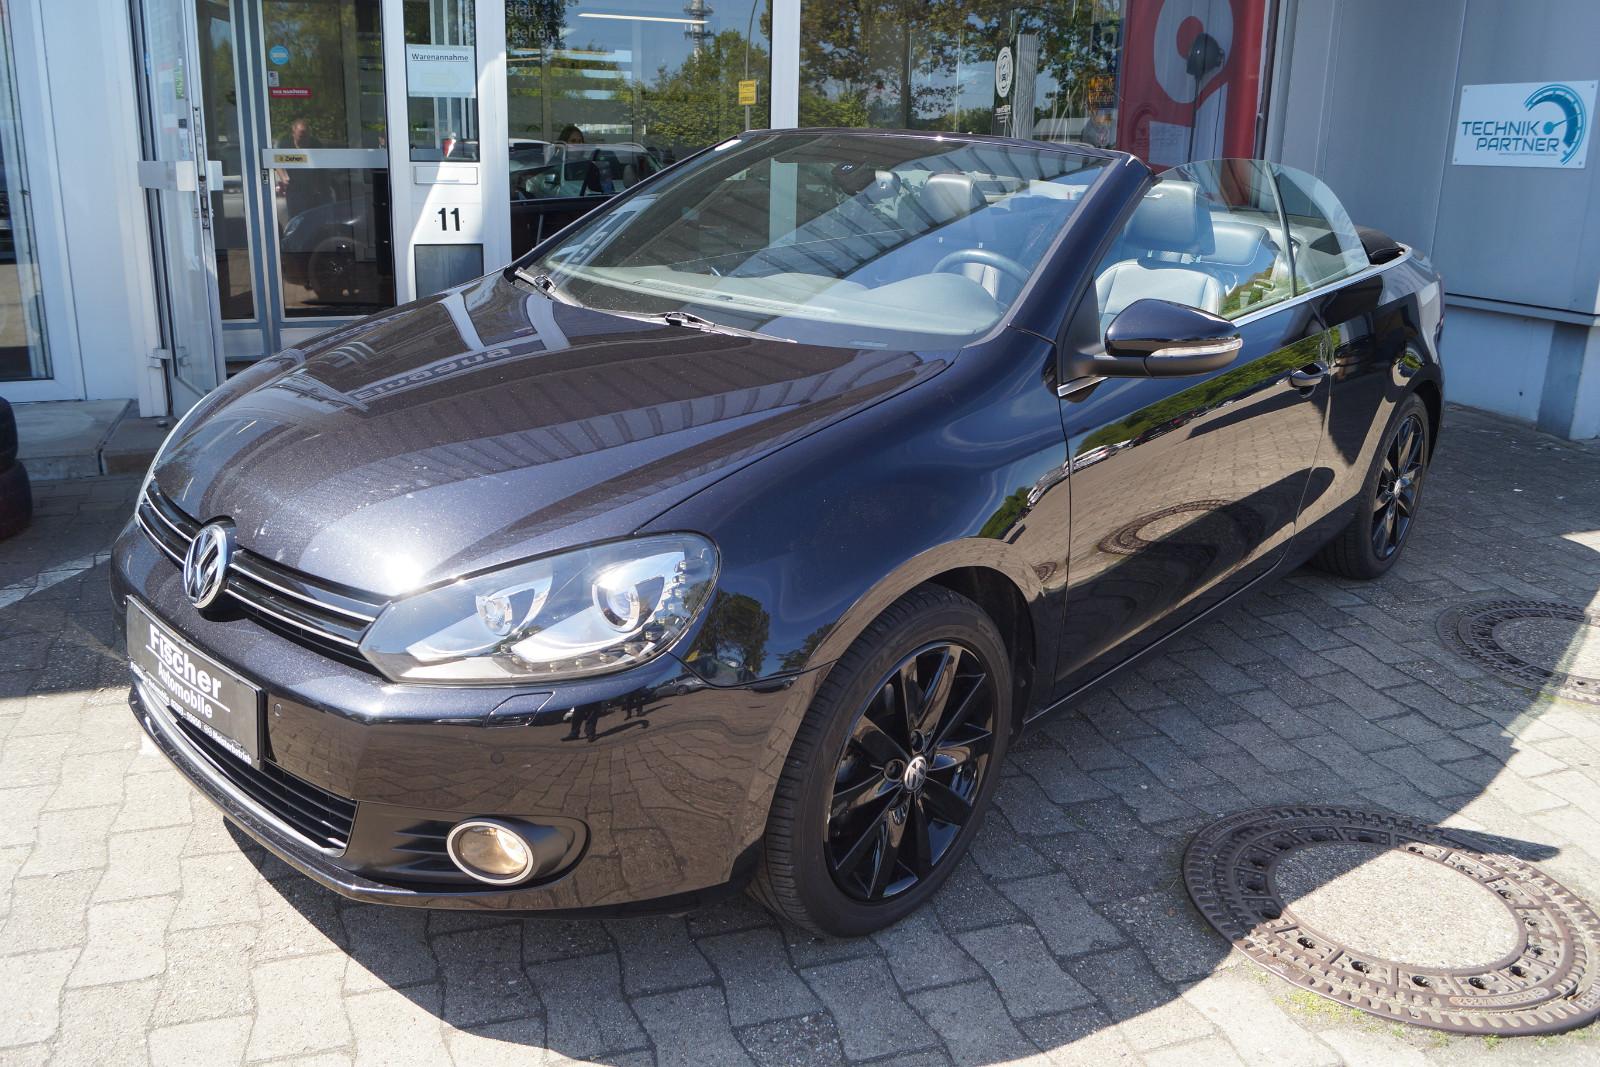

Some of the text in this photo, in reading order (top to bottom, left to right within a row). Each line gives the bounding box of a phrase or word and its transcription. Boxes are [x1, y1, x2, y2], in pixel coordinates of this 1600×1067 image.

[411, 53, 469, 61] Warenannahme
[1461, 120, 1541, 136] TECHNIK
[1476, 137, 1560, 152] PARTNER
[437, 207, 461, 231] 11
[150, 623, 222, 700] Fischer
[158, 661, 213, 719] Automobile
